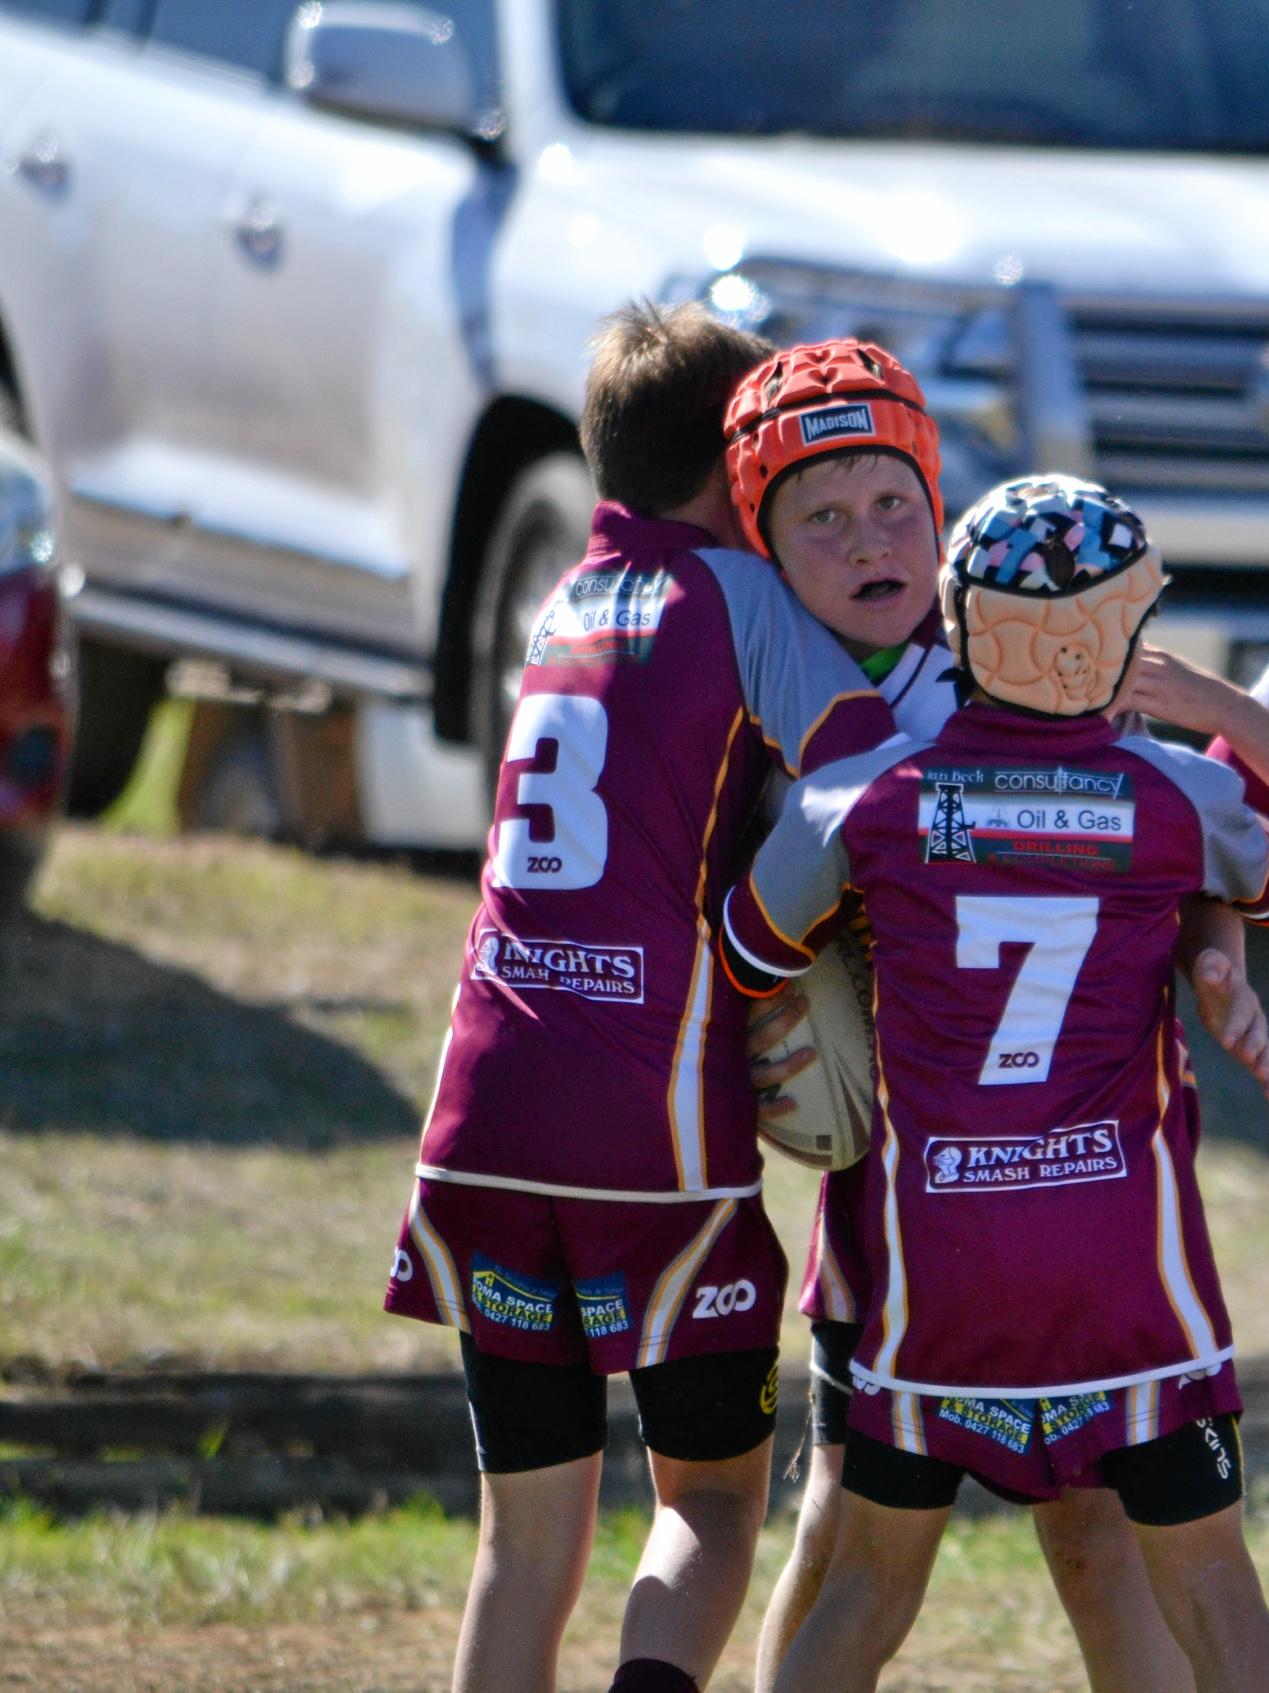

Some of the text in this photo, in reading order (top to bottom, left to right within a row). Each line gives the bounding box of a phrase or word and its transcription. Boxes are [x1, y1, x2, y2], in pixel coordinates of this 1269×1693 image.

[804, 407, 869, 441] MADISON
[583, 607, 651, 631] Oil & Gas
[492, 693, 608, 890] 3
[994, 766, 1124, 801] consultancy
[1016, 809, 1122, 831] Oil & Gas
[501, 965, 550, 982] SMAH
[955, 895, 1100, 1086] 7
[966, 1129, 1113, 1168] KNIGHTS
[962, 1156, 1118, 1184] SMASH REPAIRS
[474, 1278, 502, 1303] OMA
[505, 1295, 553, 1314] SPACE
[484, 1308, 509, 1324] 0427
[511, 1317, 529, 1330] 118
[589, 1320, 629, 1337] 118 683
[938, 1408, 1025, 1455] Mob. 0427 118 683
[953, 1397, 985, 1412] OMA
[988, 1405, 1032, 1435] SPACE
